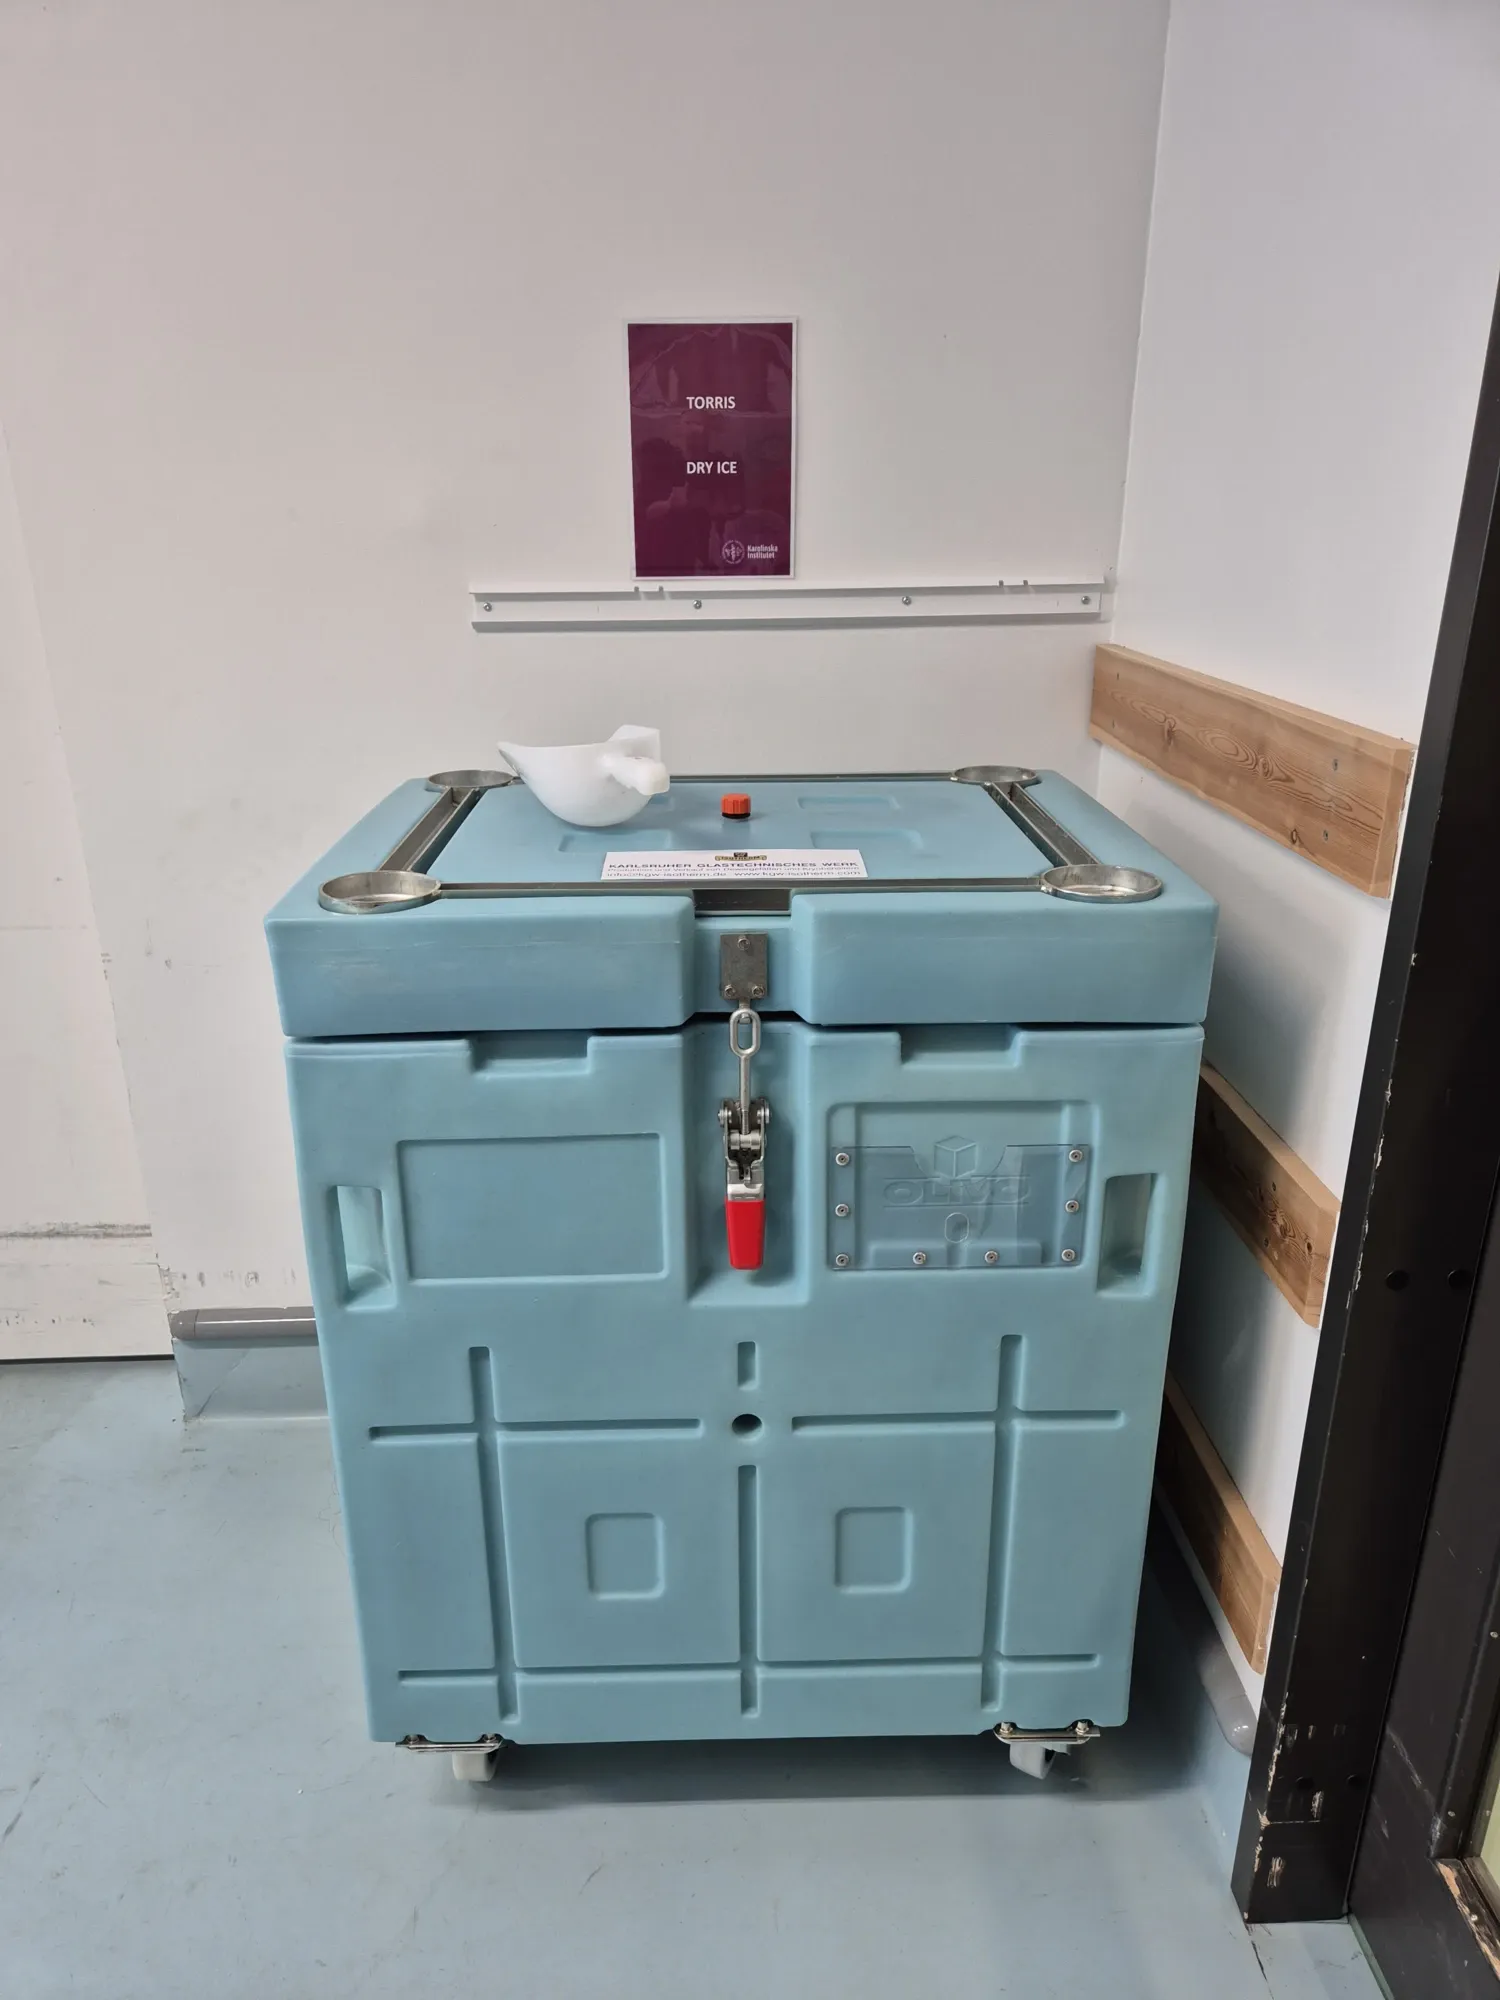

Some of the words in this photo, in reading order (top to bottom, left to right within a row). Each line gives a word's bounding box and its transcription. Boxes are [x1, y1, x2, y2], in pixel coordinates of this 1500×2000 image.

[685, 395, 736, 410] TORRIS
[685, 461, 714, 475] DRY
[716, 460, 738, 475] ICE
[747, 544, 778, 552] Karolinska
[747, 551, 775, 559] Institutet
[883, 1178, 1032, 1206] OLIVO
